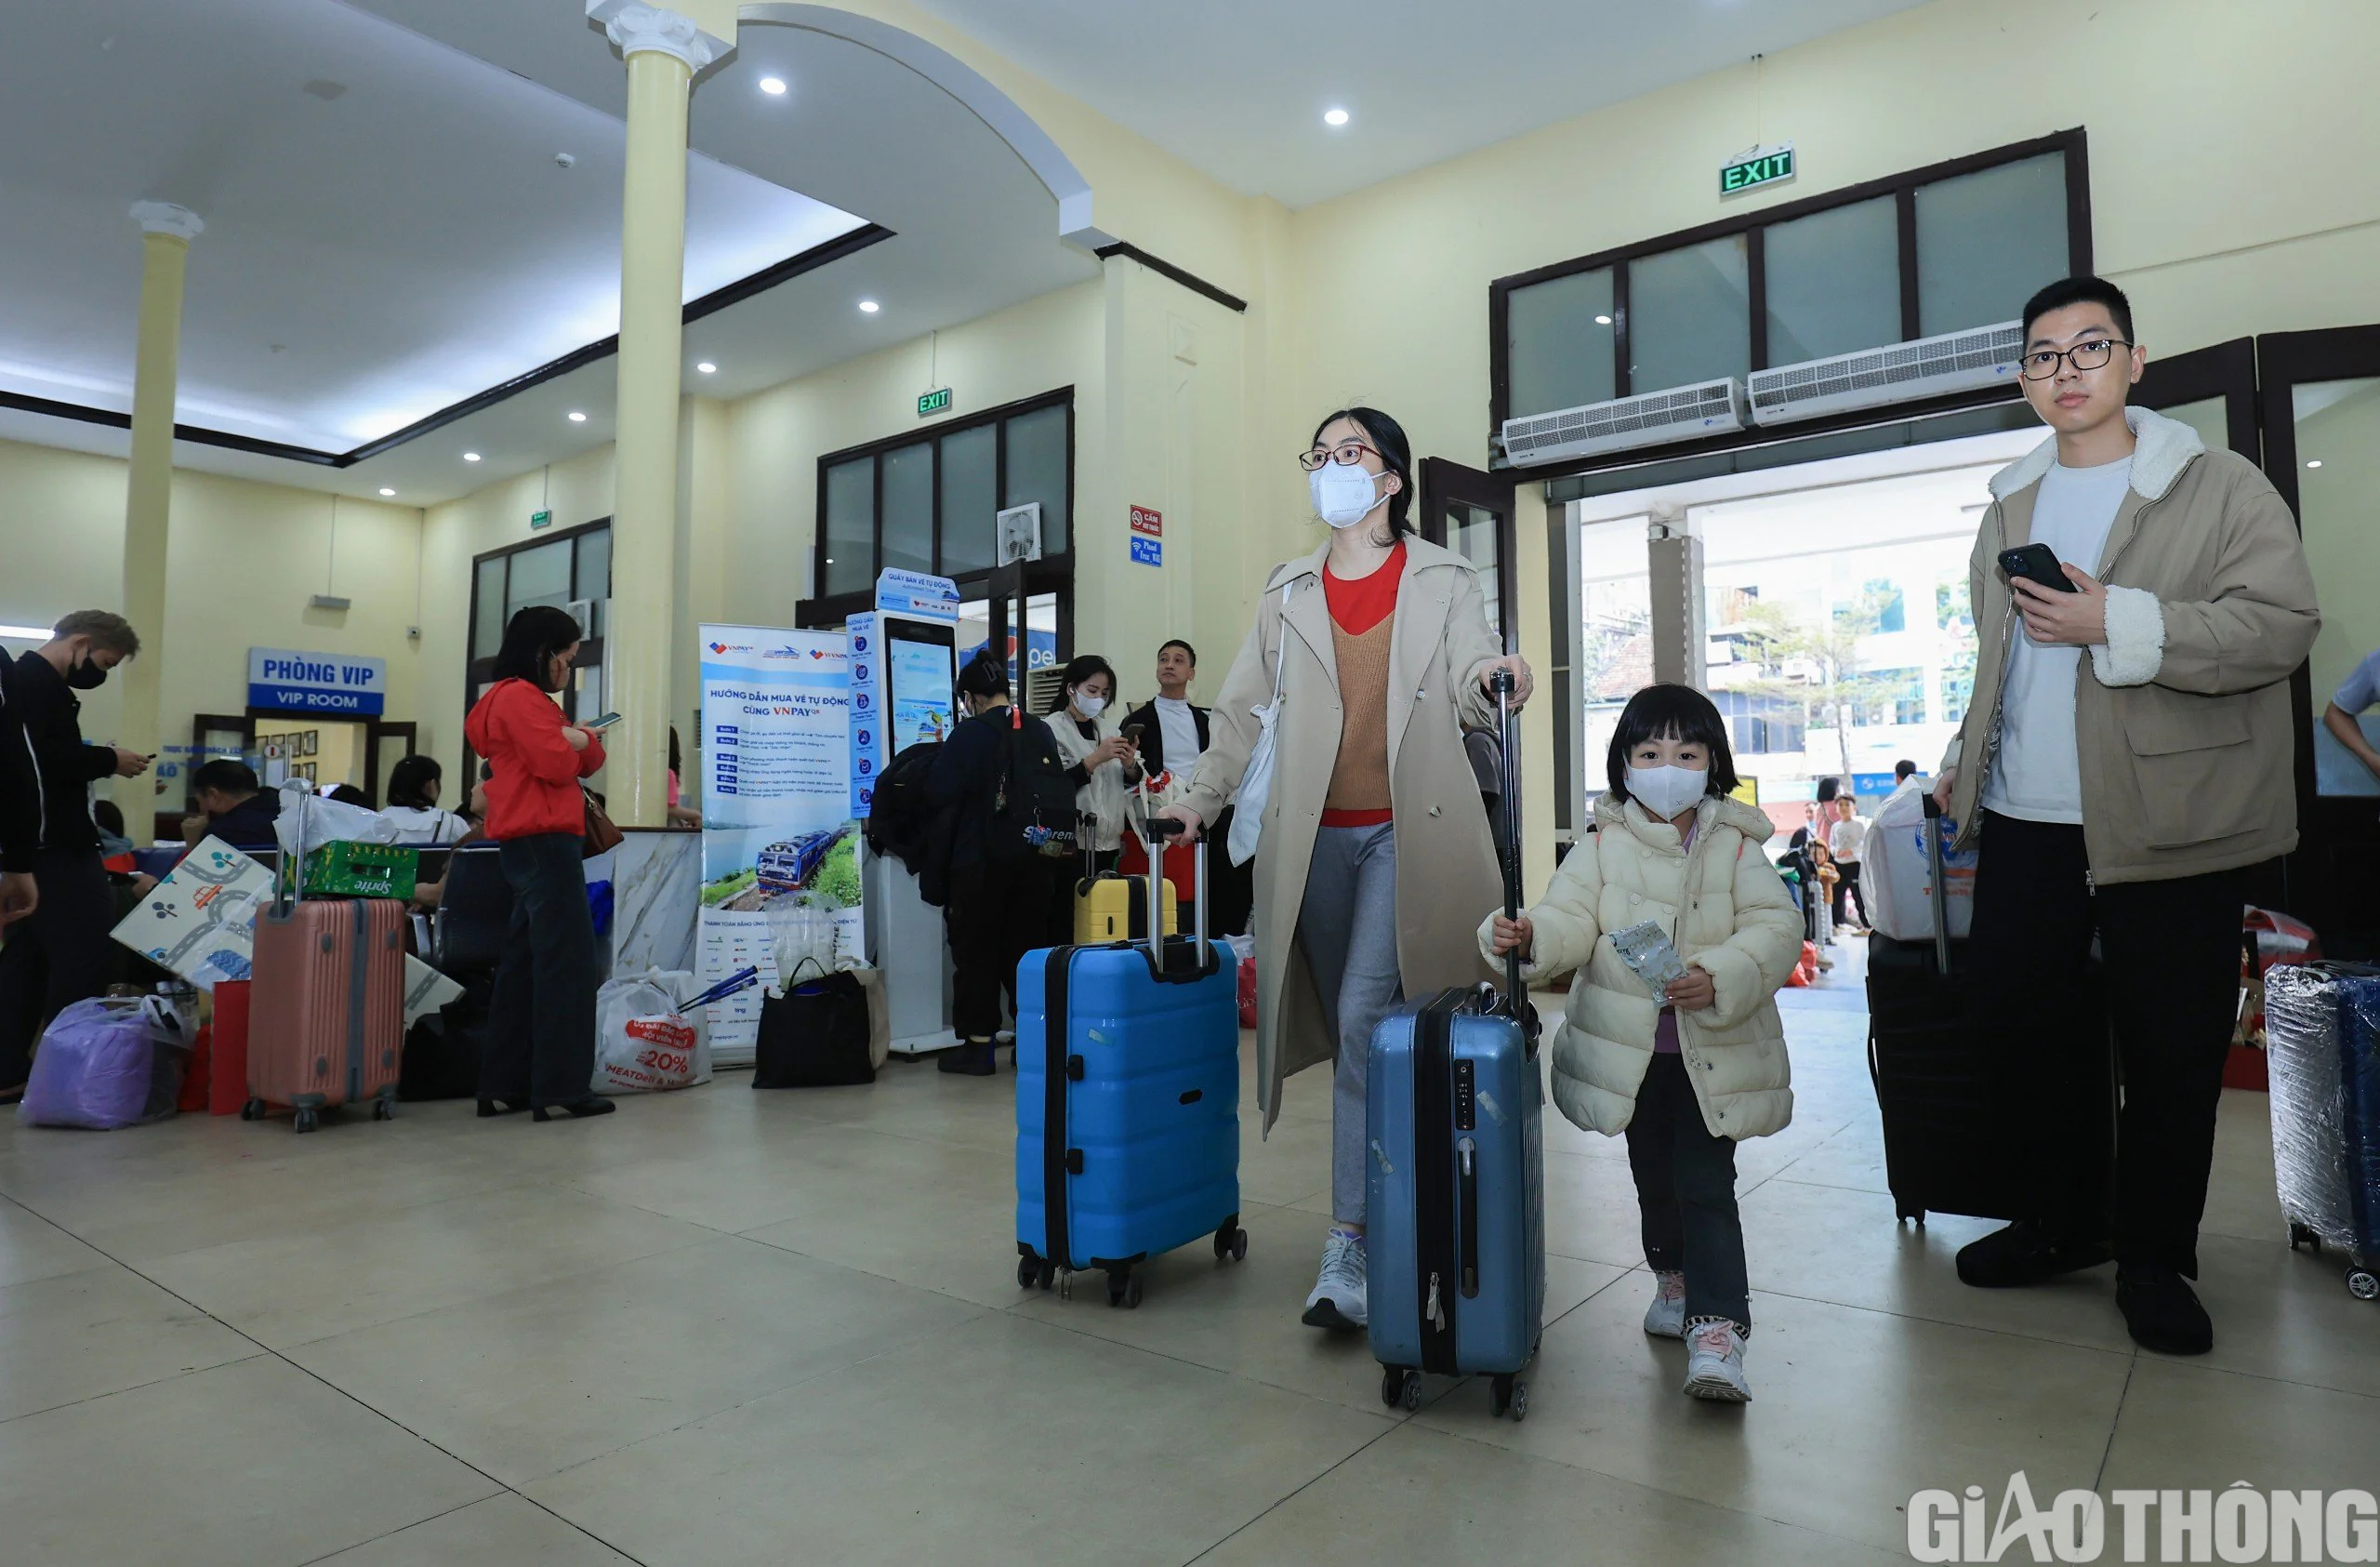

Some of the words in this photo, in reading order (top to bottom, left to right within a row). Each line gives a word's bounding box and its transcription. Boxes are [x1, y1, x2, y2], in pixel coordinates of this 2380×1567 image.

[1726, 153, 1789, 190] EXIT
[919, 391, 947, 412] EXIT
[1144, 512, 1158, 523] CẤM
[1029, 647, 1056, 670] pe
[263, 657, 336, 684] PHÒNG
[342, 665, 374, 686] VIP
[277, 692, 303, 704] VIP
[307, 694, 358, 709] ROOM
[710, 689, 747, 699] HƯỚNG
[748, 691, 769, 702] DẪN
[771, 695, 792, 703] MUA
[794, 695, 806, 704] VÉ
[809, 697, 821, 707] TỰ
[744, 706, 771, 716] CÙNG
[354, 880, 392, 895] Sprite
